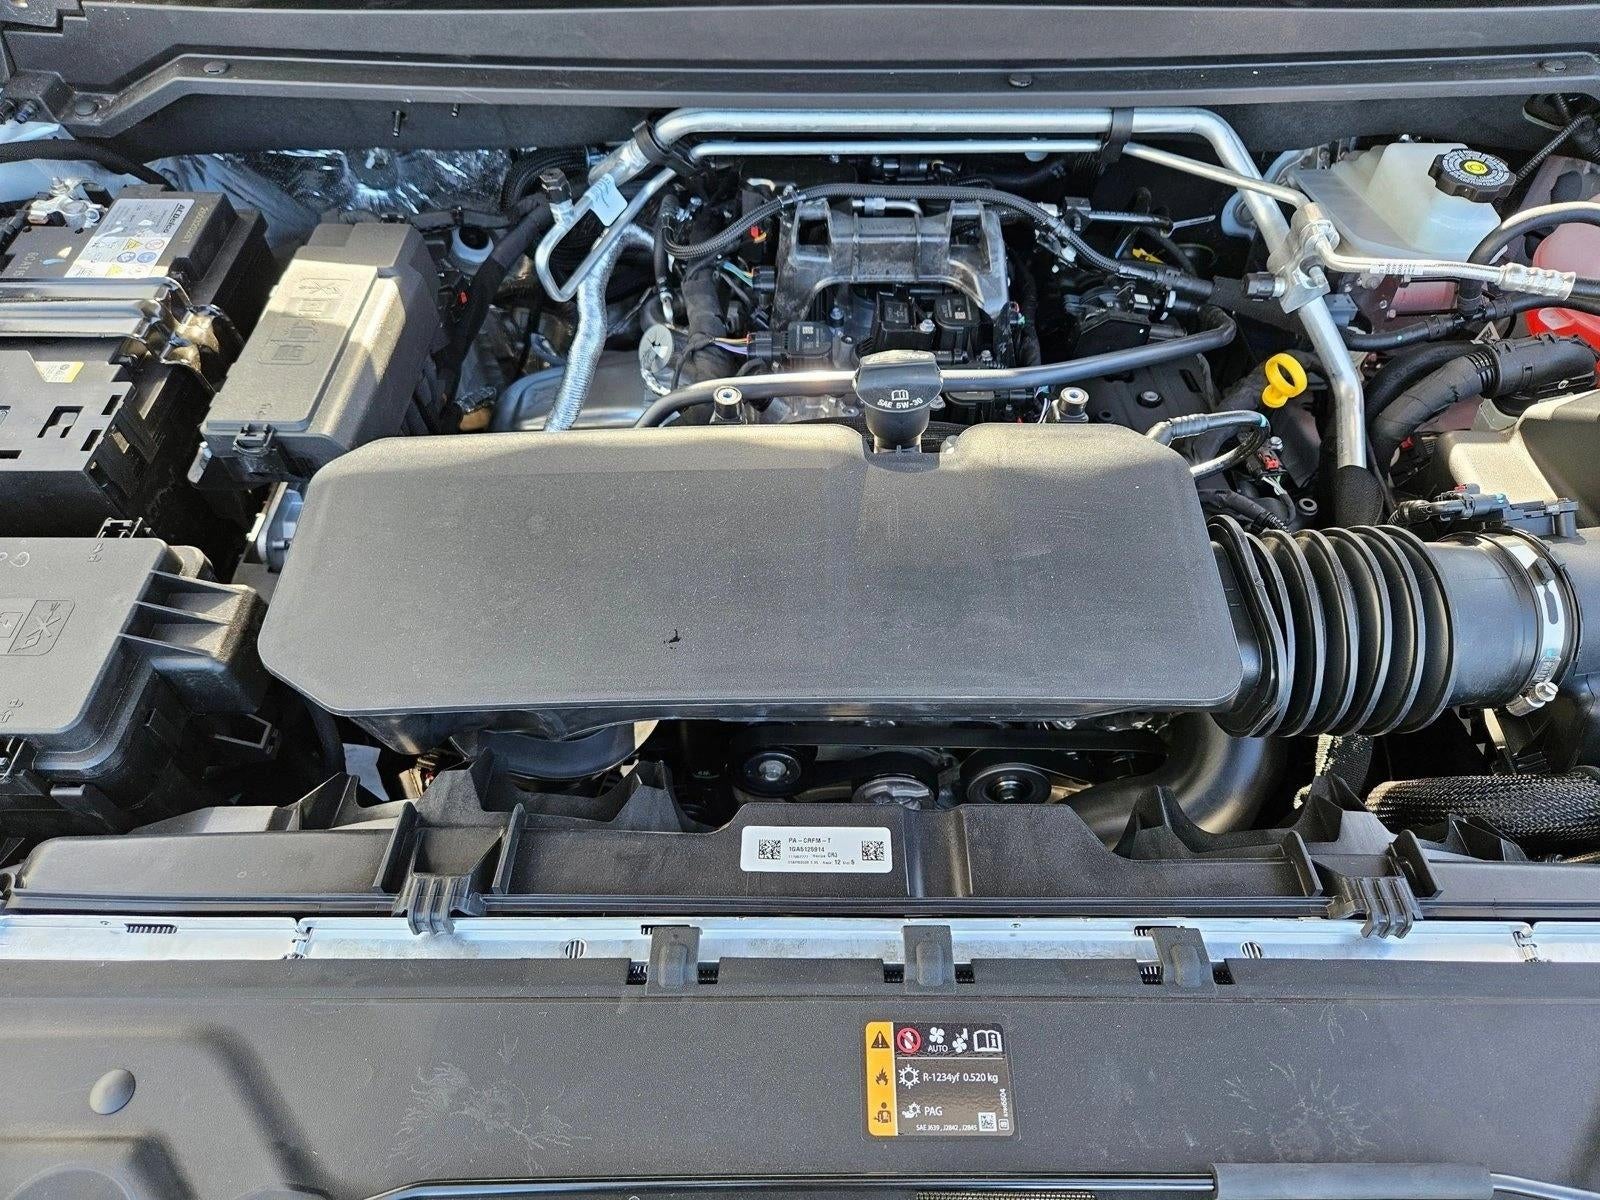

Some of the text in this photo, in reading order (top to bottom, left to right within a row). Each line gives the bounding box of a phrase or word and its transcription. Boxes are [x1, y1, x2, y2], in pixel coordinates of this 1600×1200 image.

[877, 397, 924, 409] SAE 5W-30
[928, 1045, 948, 1053] AUTO
[923, 1072, 998, 1084] R-1234yf 0.520 kg
[924, 1106, 943, 1116] PAG
